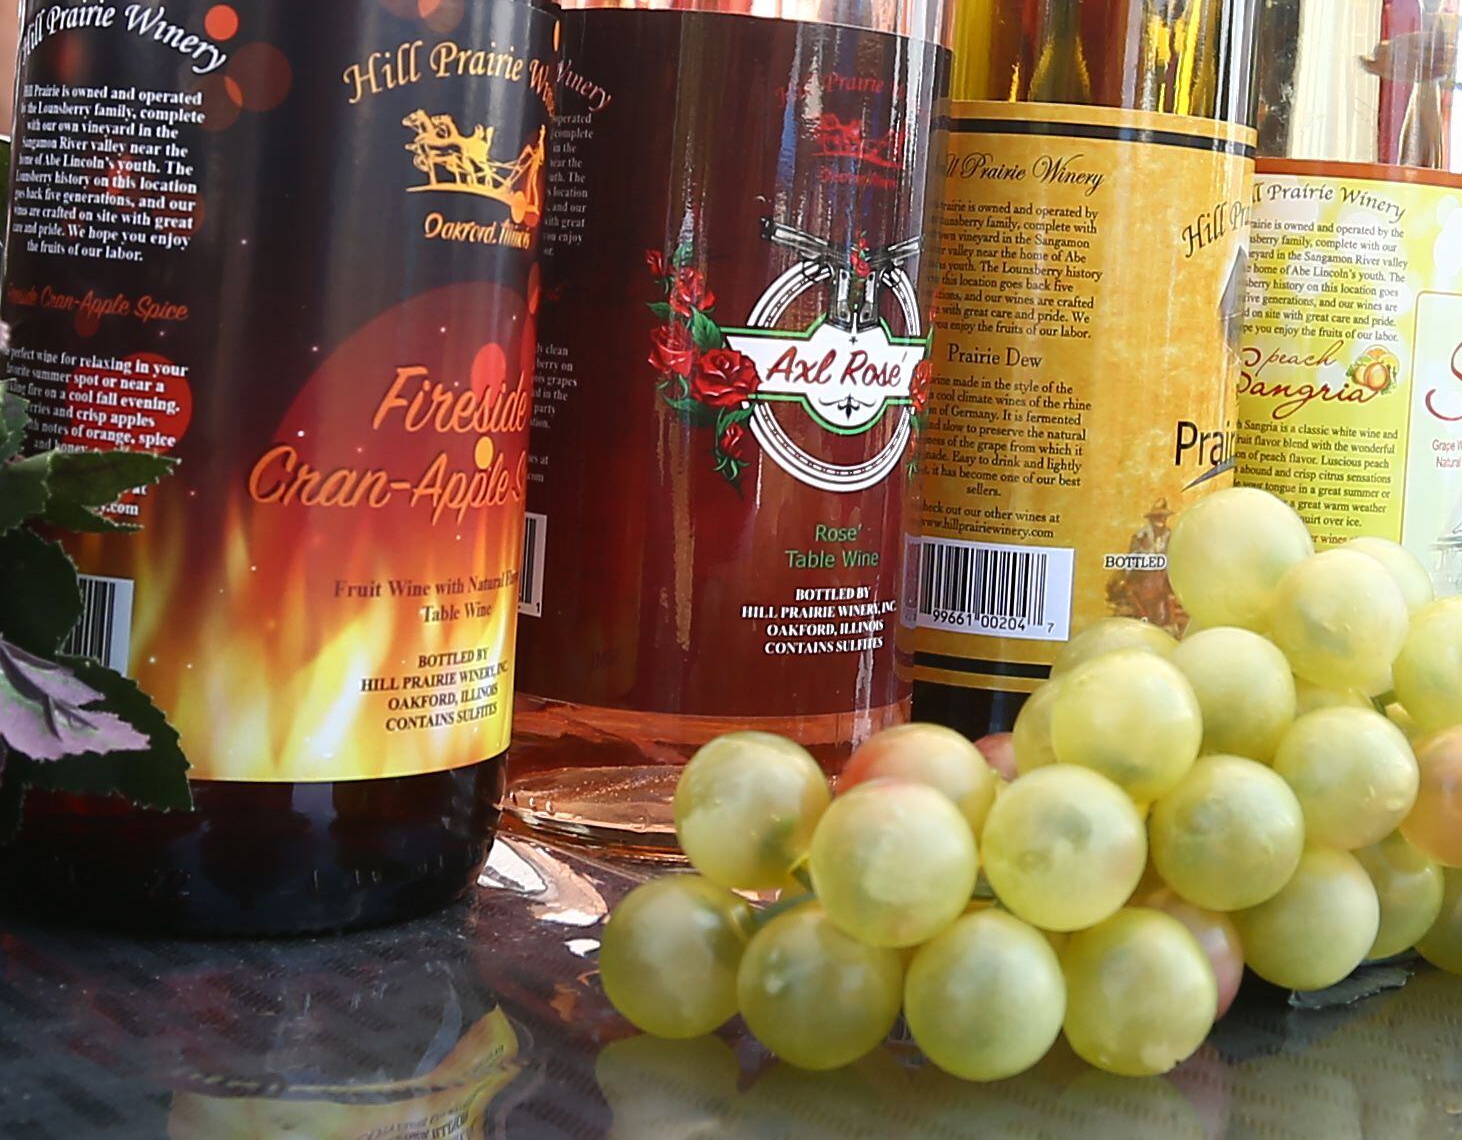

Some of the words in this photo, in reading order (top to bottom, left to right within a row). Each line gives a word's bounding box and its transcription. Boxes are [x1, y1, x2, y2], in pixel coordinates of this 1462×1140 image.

[124, 3, 227, 74] Winery
[343, 40, 423, 103] Hill
[430, 42, 523, 81] Prairie
[138, 89, 203, 106] operated
[94, 103, 137, 121] family,
[140, 107, 205, 125] complete
[81, 120, 135, 138] vineyard
[91, 138, 125, 156] valley
[63, 155, 114, 170] Lincoln's
[117, 159, 160, 174] youth.
[164, 160, 193, 176] The
[960, 152, 1026, 180] Prairie
[1032, 154, 1104, 197] Winery
[140, 178, 197, 194] location
[63, 191, 135, 208] generations,
[1267, 183, 1335, 201] Prairie
[1340, 187, 1406, 224] Winery
[978, 201, 1010, 214] owned
[1035, 205, 1083, 219] operated
[155, 214, 193, 231] great
[987, 216, 1020, 231] family,
[1024, 220, 1070, 236] complete
[1073, 220, 1097, 234] with
[1182, 201, 1228, 258] Hill
[1284, 220, 1314, 232] owned
[1336, 224, 1375, 236] operated
[88, 225, 118, 243] hope
[150, 233, 191, 250] enjoy
[960, 231, 999, 246] vineyard
[1035, 234, 1090, 249] Sangamon
[1281, 235, 1313, 249] family,
[1316, 238, 1358, 251] complete
[105, 245, 143, 261] labor.
[1304, 251, 1353, 266] Sangamon
[1002, 262, 1062, 278] Lounsberry
[1065, 266, 1103, 282] history
[1313, 266, 1356, 280] Lincoln's
[1273, 280, 1304, 293] history
[1341, 283, 1376, 296] location
[41, 284, 131, 318] Cran-Apple
[134, 294, 189, 323] Spice
[1057, 296, 1094, 309] crafted
[1263, 295, 1316, 308] generations,
[1061, 326, 1090, 339] labor.
[1274, 323, 1299, 338] enjoy
[948, 343, 1000, 365] Prairie
[1005, 347, 1042, 367] Dew
[1256, 340, 1344, 378] peach
[80, 355, 131, 375] relaxing
[152, 362, 189, 378] your
[766, 346, 836, 385] Axl
[120, 378, 152, 392] near
[120, 396, 180, 415] evening.
[372, 365, 526, 433] Fireside
[1063, 398, 1092, 411] rhine
[111, 412, 155, 429] apples
[951, 406, 999, 422] Germany.
[1027, 412, 1080, 426] fermented
[980, 425, 1024, 438] preserve
[1048, 428, 1085, 441] natural
[1245, 420, 1277, 434] Sangria
[1298, 424, 1329, 437] classic
[1332, 426, 1357, 439] white
[139, 433, 177, 449] spice
[1039, 443, 1071, 455] which
[1175, 421, 1236, 467] Prair
[1284, 437, 1308, 449] blend
[1351, 442, 1395, 455] wonderful
[1432, 440, 1455, 453] Grape
[1047, 458, 1082, 475] lightly
[1260, 452, 1286, 465] peach
[1321, 455, 1361, 467] Luscious
[1436, 457, 1462, 469] Natural
[959, 466, 997, 481] become
[1240, 464, 1272, 476] abound
[1347, 472, 1391, 484] sensations
[249, 445, 509, 526] Cran-Apple
[966, 484, 1001, 498] sellers.
[1265, 483, 1296, 495] tongue
[1344, 487, 1378, 499] summer
[946, 505, 961, 516] out
[964, 507, 982, 517] our
[984, 507, 1012, 521] other
[1015, 511, 1046, 523] wines
[1050, 513, 1060, 524] at
[1352, 501, 1387, 514] weather
[785, 550, 836, 568] Table
[841, 550, 879, 568] Wine
[1105, 555, 1167, 569] BOTTLED
[334, 580, 382, 598] Fruit
[388, 579, 431, 598] Wine
[434, 579, 464, 595] with
[467, 572, 504, 593] Natural
[796, 588, 854, 601] BOTTLED
[856, 587, 871, 599] BY
[421, 605, 459, 623] Table
[464, 601, 492, 619] Wine
[741, 606, 779, 619] HILL
[781, 606, 836, 619] PRAIRIE
[933, 609, 973, 627] 99661
[981, 614, 1025, 632] 00204
[1048, 623, 1056, 633] 7
[767, 624, 837, 637] OAKFORD,
[840, 620, 884, 634] ILLINOIS
[764, 642, 834, 655] CONTAINS
[836, 637, 883, 652] SULFITES
[418, 650, 474, 669] BOTTLED
[476, 647, 489, 661] BY
[361, 678, 399, 693] HILL
[403, 673, 456, 690] PRAIRIE
[388, 693, 458, 712] OAKFORD,
[461, 683, 498, 703] ILLINOIS
[386, 713, 454, 732] CONTAINS
[457, 702, 498, 723] SULFITES
